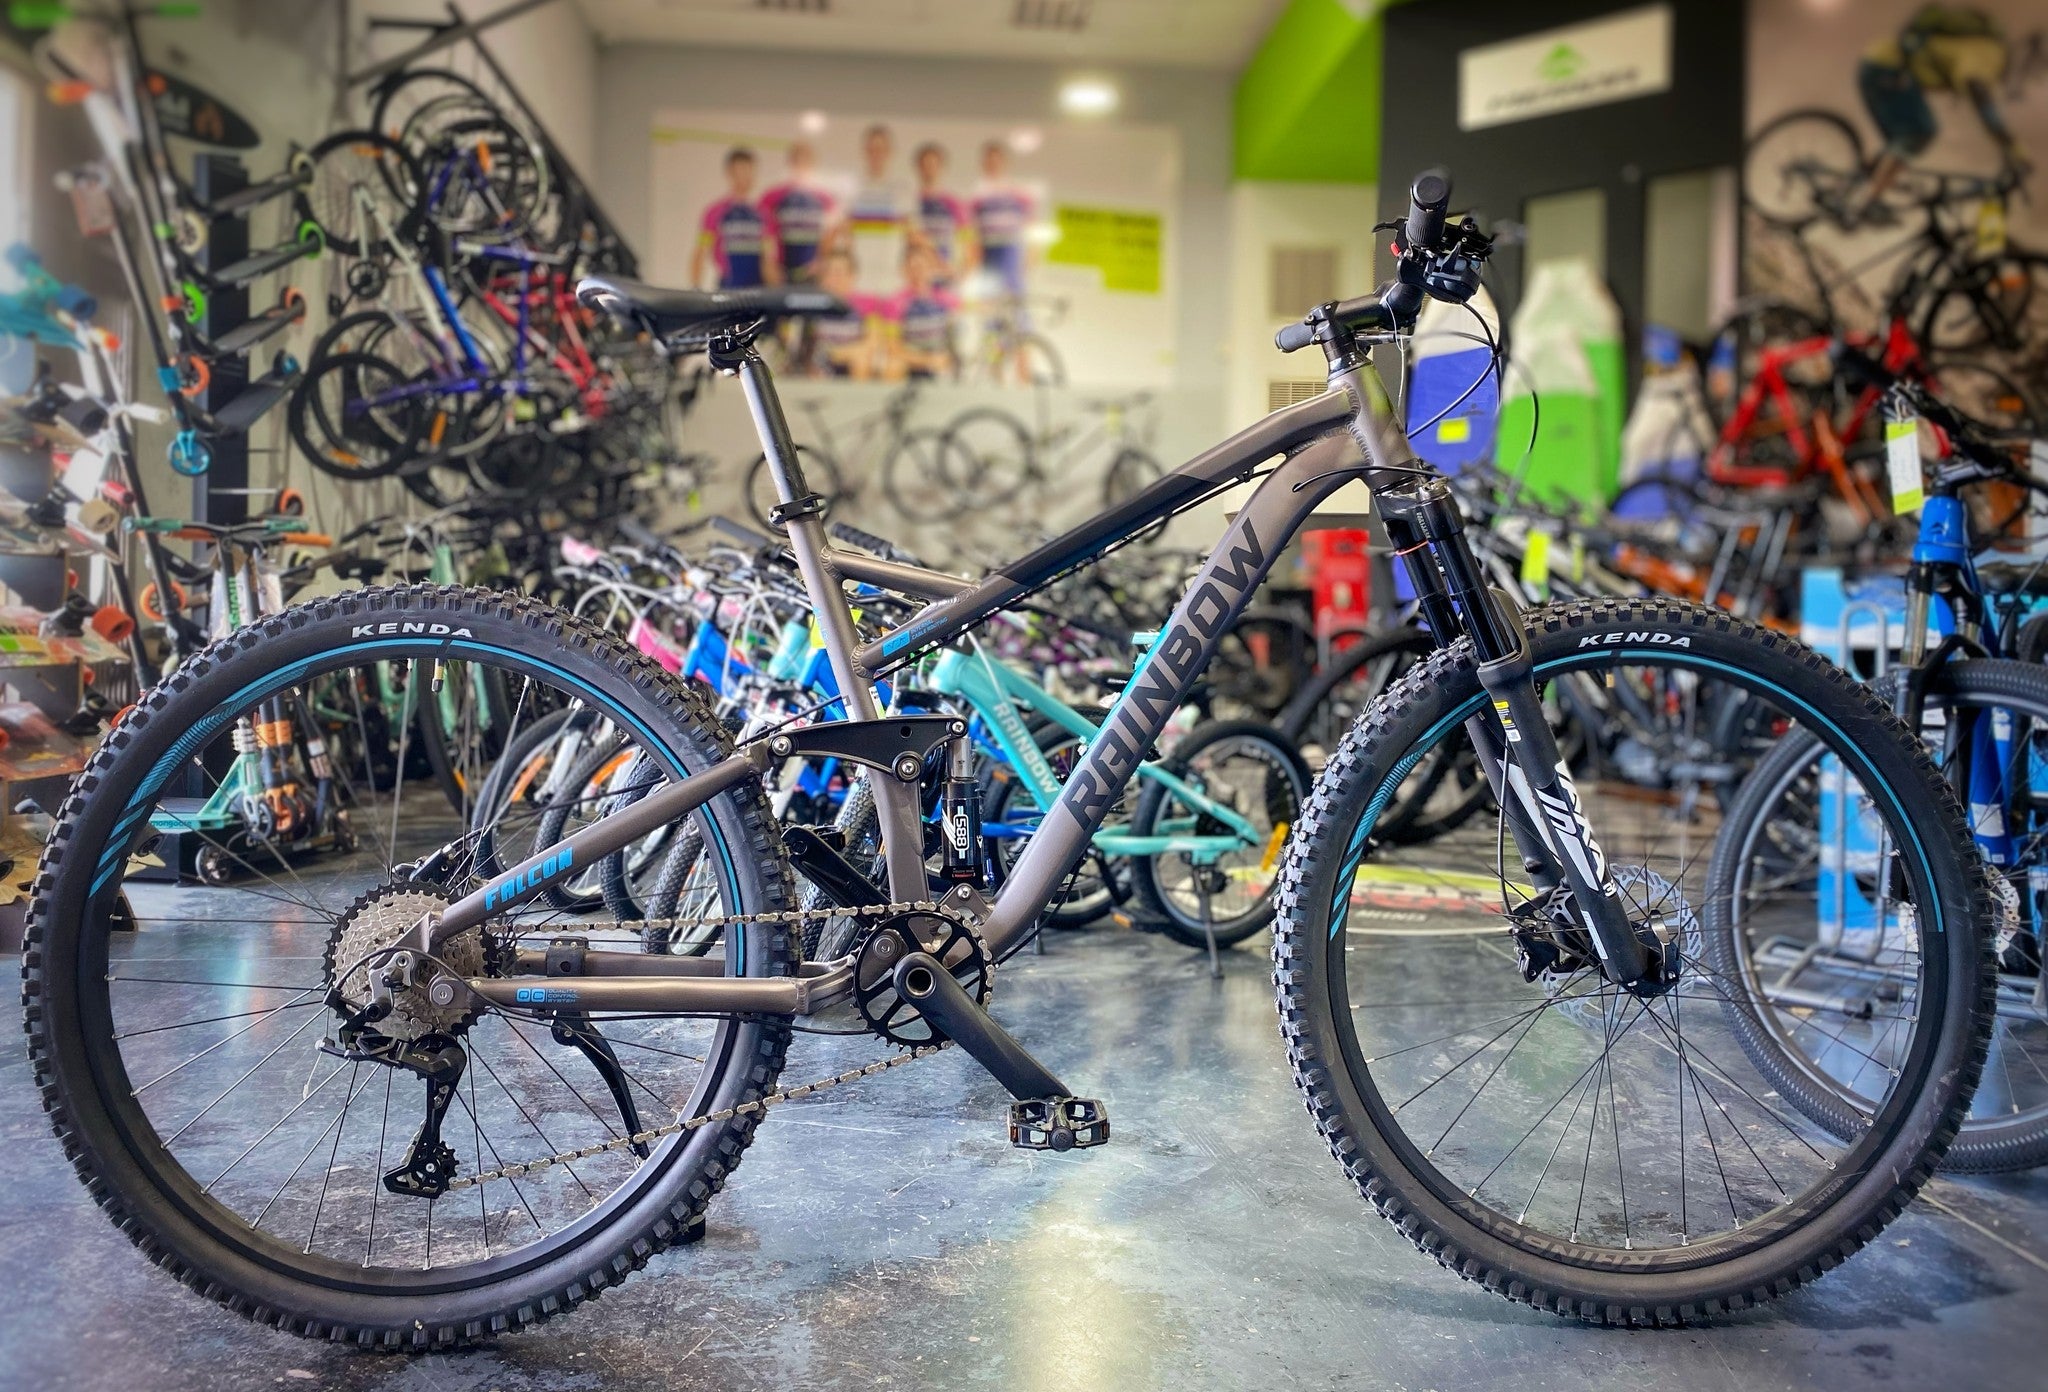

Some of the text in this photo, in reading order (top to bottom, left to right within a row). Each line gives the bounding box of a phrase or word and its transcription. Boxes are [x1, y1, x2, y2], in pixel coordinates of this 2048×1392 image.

[352, 622, 472, 638] KENDA
[1579, 632, 1691, 648] KENDA
[1063, 518, 1264, 830] RAINBOW
[993, 702, 1059, 793] RAINBOW
[955, 818, 967, 847] 588
[485, 847, 573, 911] FALCON
